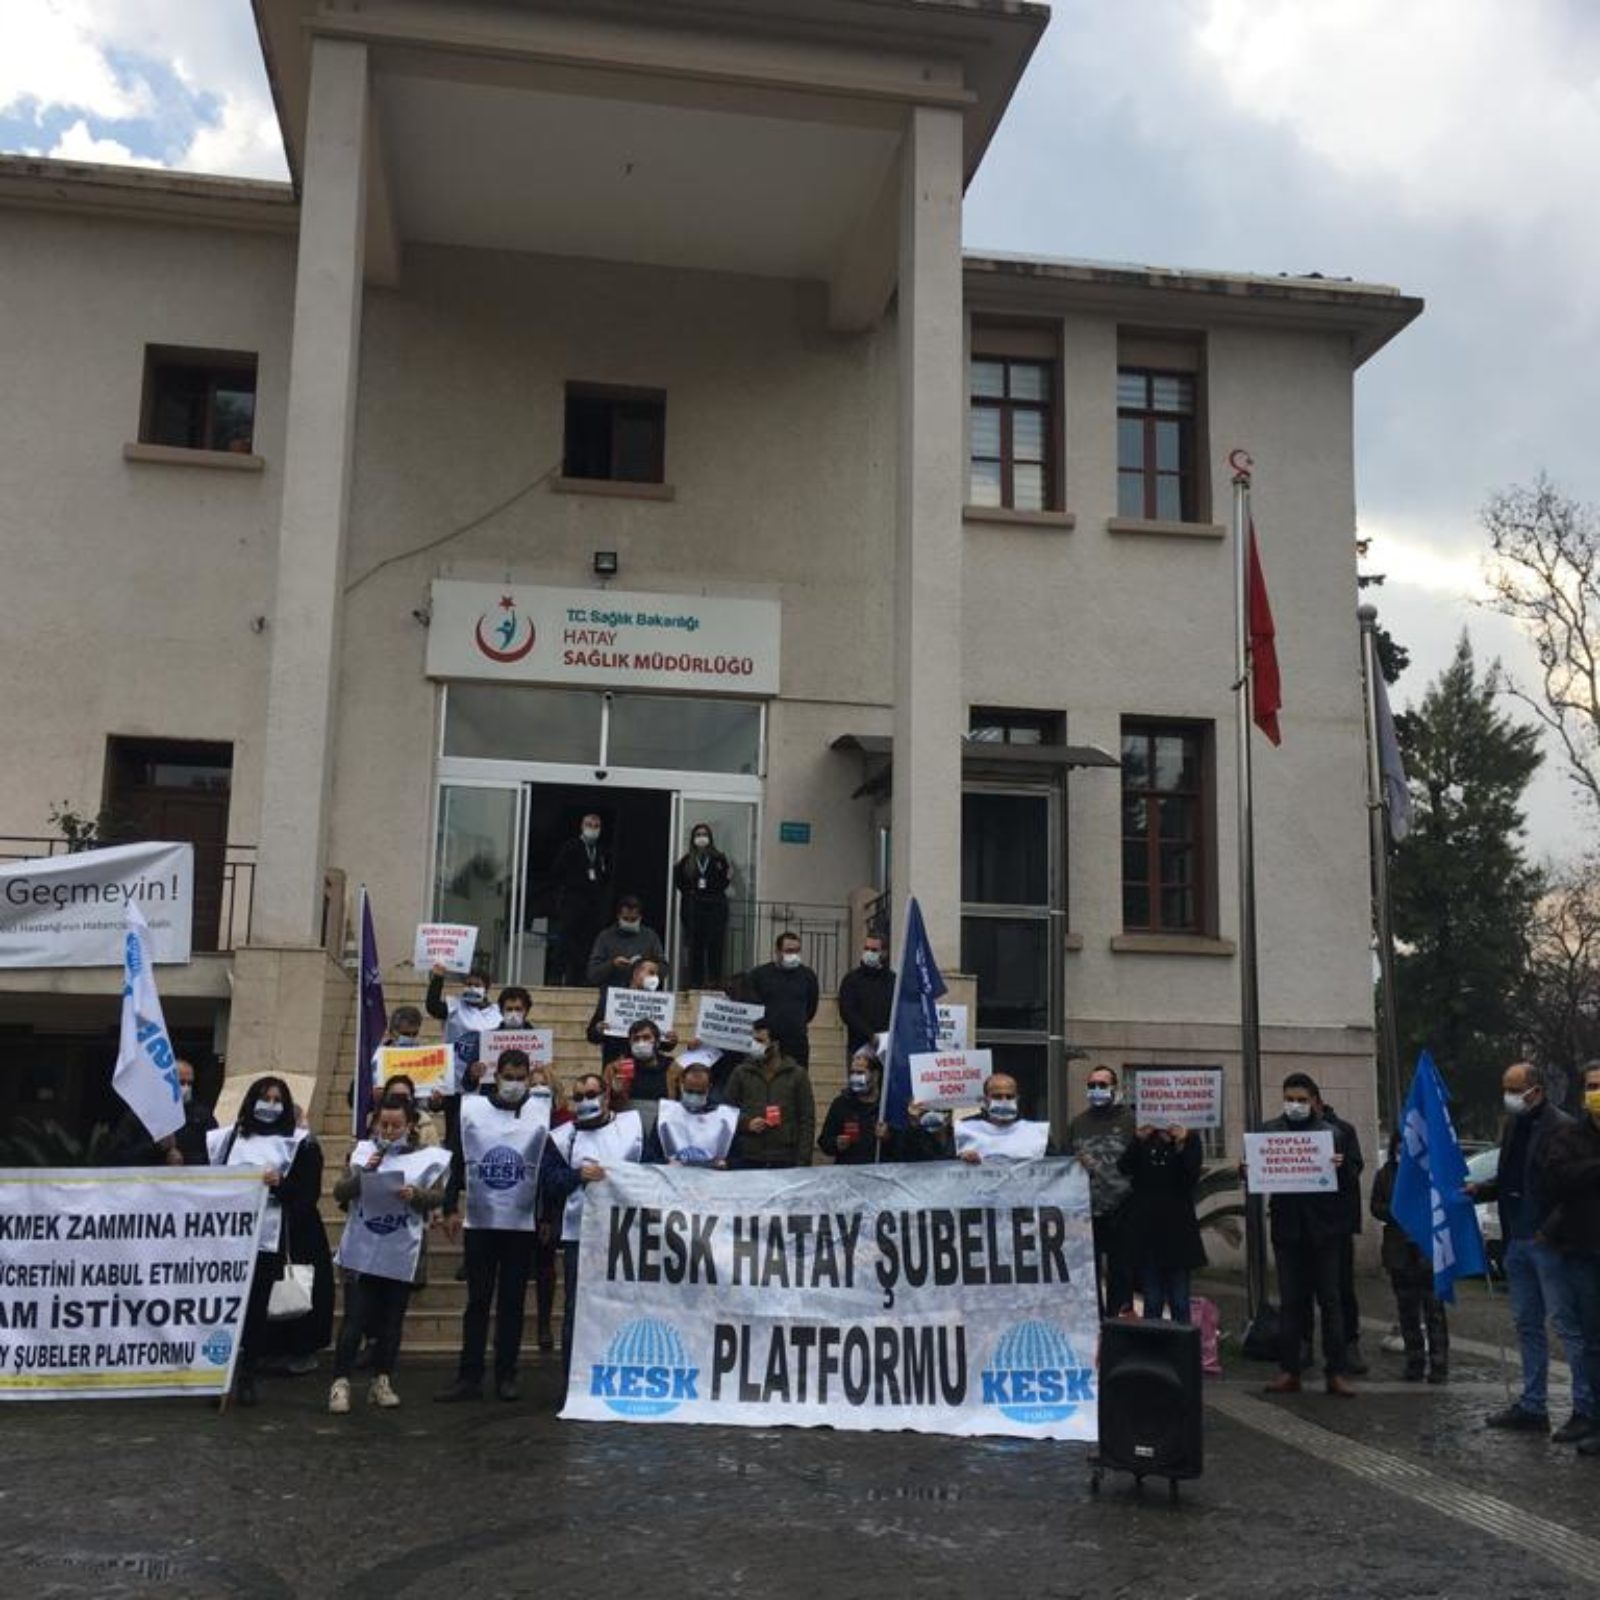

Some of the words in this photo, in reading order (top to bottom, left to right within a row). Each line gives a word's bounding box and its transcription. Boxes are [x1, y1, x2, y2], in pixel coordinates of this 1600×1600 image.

[590, 609, 632, 627] Sağlık
[636, 612, 700, 631] Bakanlığı
[563, 629, 617, 646] HATAY
[563, 649, 630, 668] SAĞLIK
[633, 651, 753, 676] MÜDÜRLÜĞÜ
[478, 1164, 527, 1181] KESK
[66, 1213, 177, 1240] ZAMMINA
[607, 1205, 719, 1285] KESK
[732, 1211, 862, 1288] HATAY
[875, 1205, 1070, 1309] ŞUBELER
[81, 1262, 143, 1288] KABUL
[50, 1293, 242, 1329] İSTİYORUZ
[14, 1344, 91, 1376] ŞUBELER
[95, 1341, 196, 1368] PLATFORMU
[710, 1323, 967, 1407] PLATFORMU
[590, 1363, 700, 1400] KESK
[981, 1366, 1096, 1405] KESK
